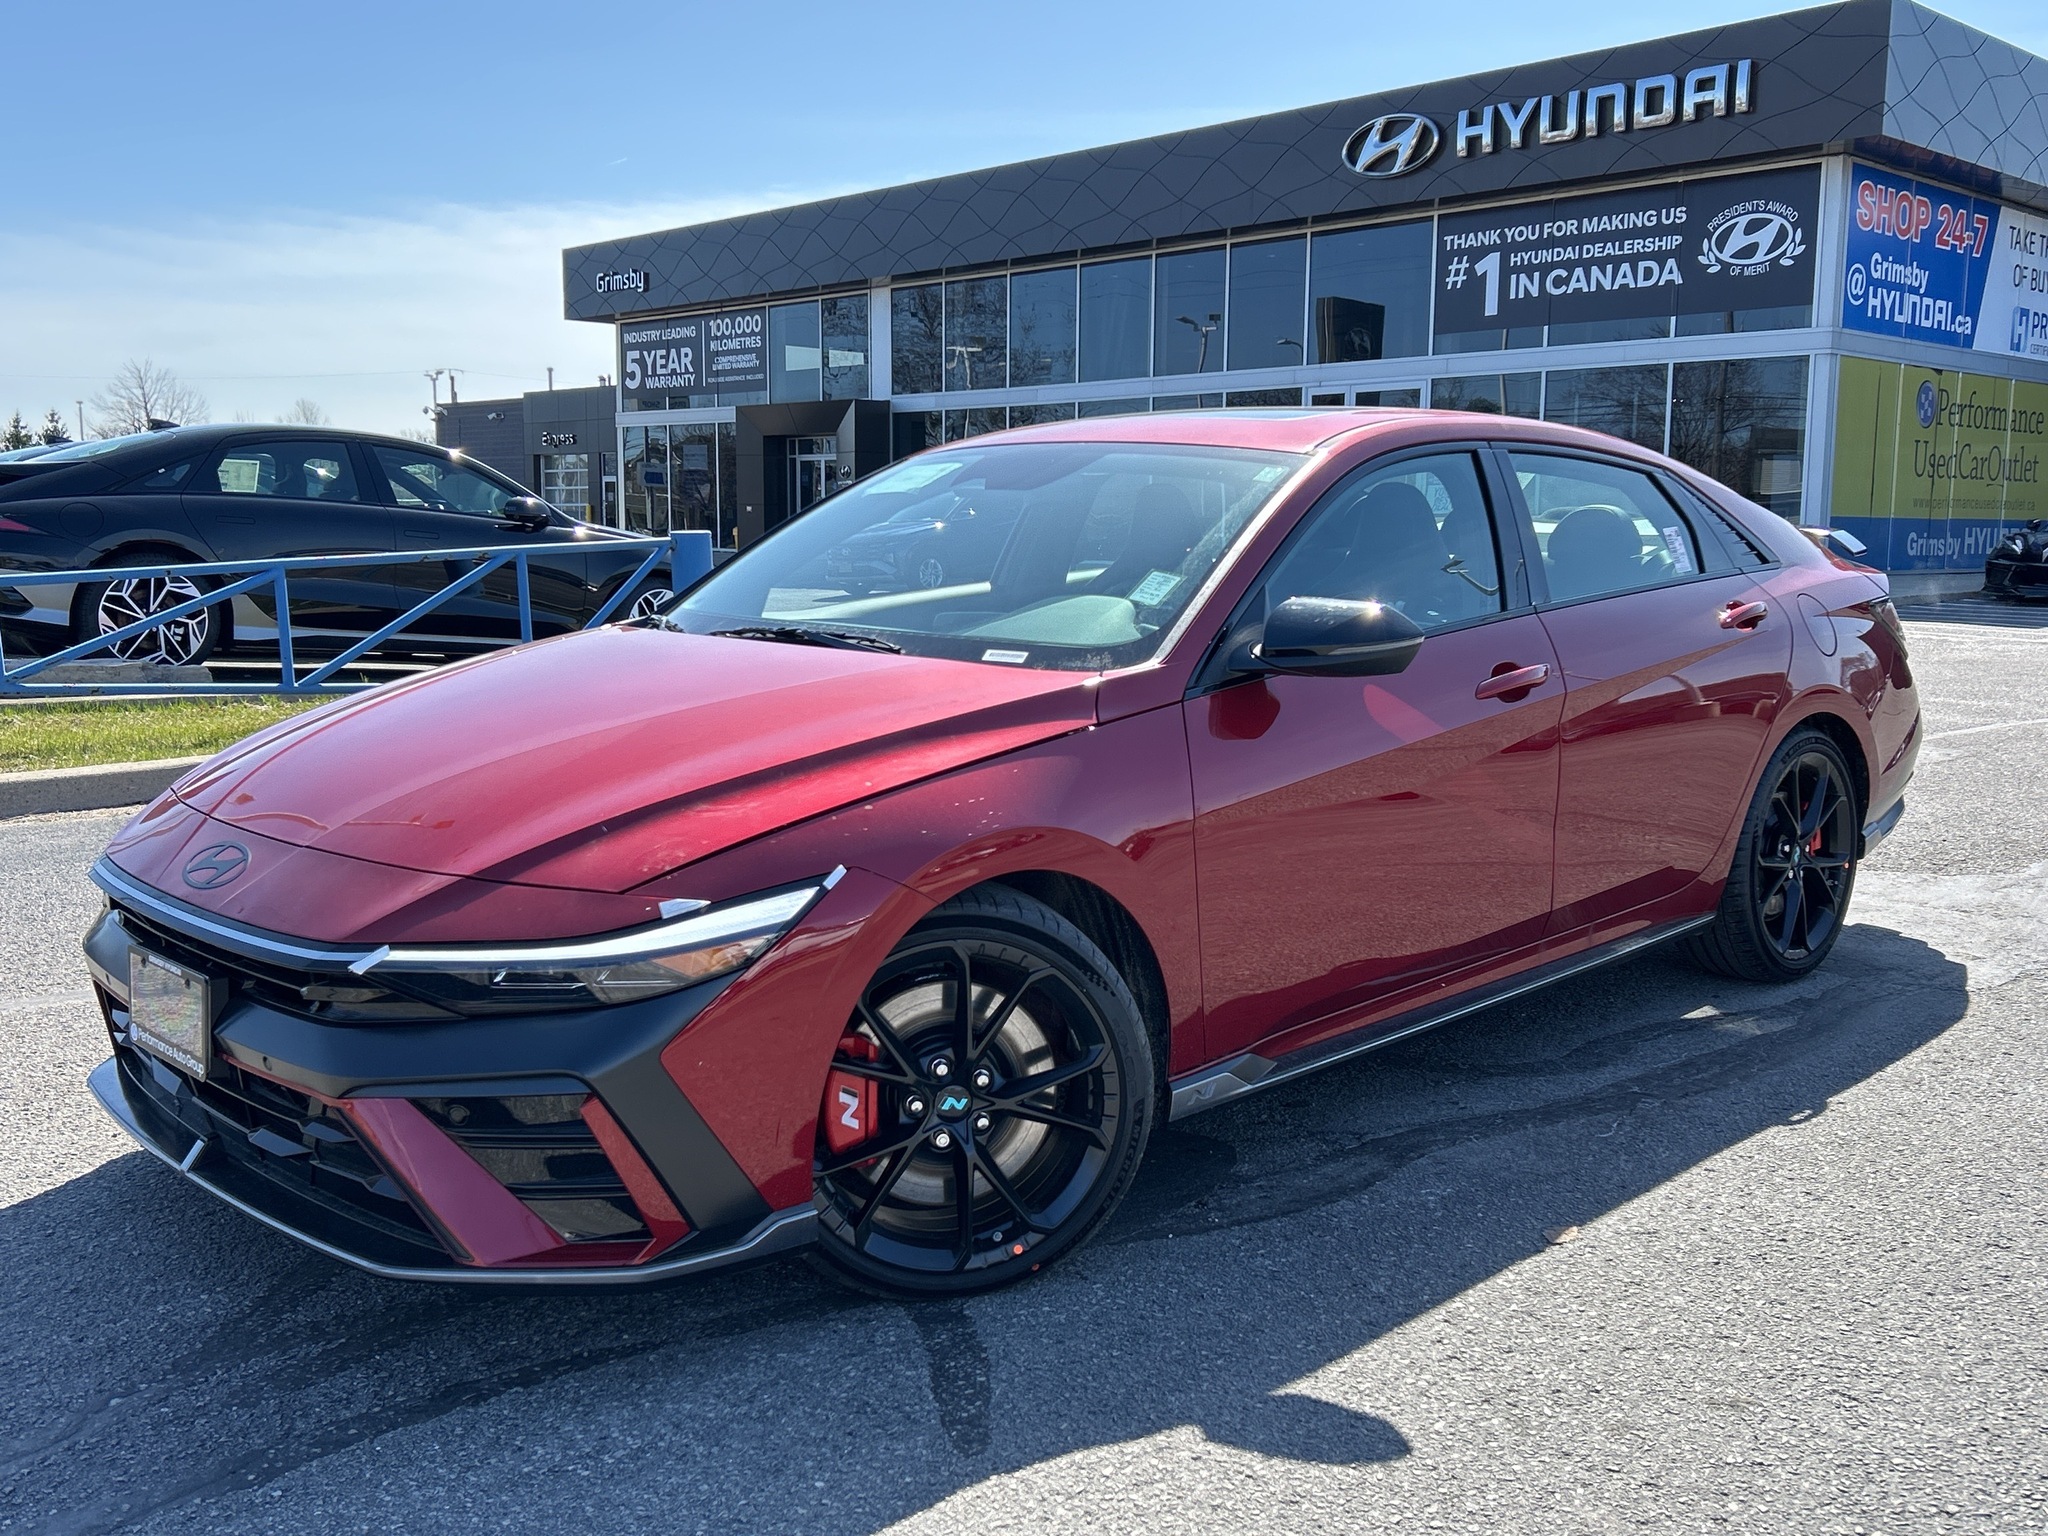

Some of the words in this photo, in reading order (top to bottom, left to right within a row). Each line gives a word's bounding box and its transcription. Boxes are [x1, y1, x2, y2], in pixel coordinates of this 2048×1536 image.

[1456, 59, 1752, 157] HYUNDAI
[1443, 229, 1502, 250] THANK
[1504, 223, 1540, 244] YOU
[1543, 219, 1578, 239] FOR
[1582, 211, 1657, 234] MAKING
[1661, 206, 1687, 225] US
[1707, 200, 1765, 232] PRESIDENT'S
[1766, 201, 1799, 222] AWARD
[1856, 180, 1932, 243] SHOP
[1935, 204, 1989, 258] 24-7
[1510, 246, 1579, 267] HYUNDAI
[1582, 235, 1683, 259] DEALERSHIP
[2009, 226, 2037, 255] TAKE
[596, 268, 644, 292] Grimsby
[1509, 271, 1541, 300] IN
[1546, 258, 1683, 296] CANADA
[1729, 265, 1742, 276] OF
[1743, 261, 1771, 276] MERIT
[1847, 263, 1867, 306] @
[1870, 252, 1929, 294] Grimsby
[2013, 264, 2029, 288] OF
[709, 315, 761, 337] 100,000
[1867, 286, 1972, 335] HYUNDAI.ca
[623, 329, 661, 344] INDUSTRY
[662, 326, 696, 341] LEADING
[710, 336, 761, 351] KILOMETRES
[625, 350, 642, 390] 5
[643, 347, 694, 376] YEAR
[645, 374, 696, 389] WARRANTY
[1937, 388, 2044, 435] Performance
[1913, 440, 2039, 483] UsedCarOutlet
[1907, 531, 1961, 560] Grimsby
